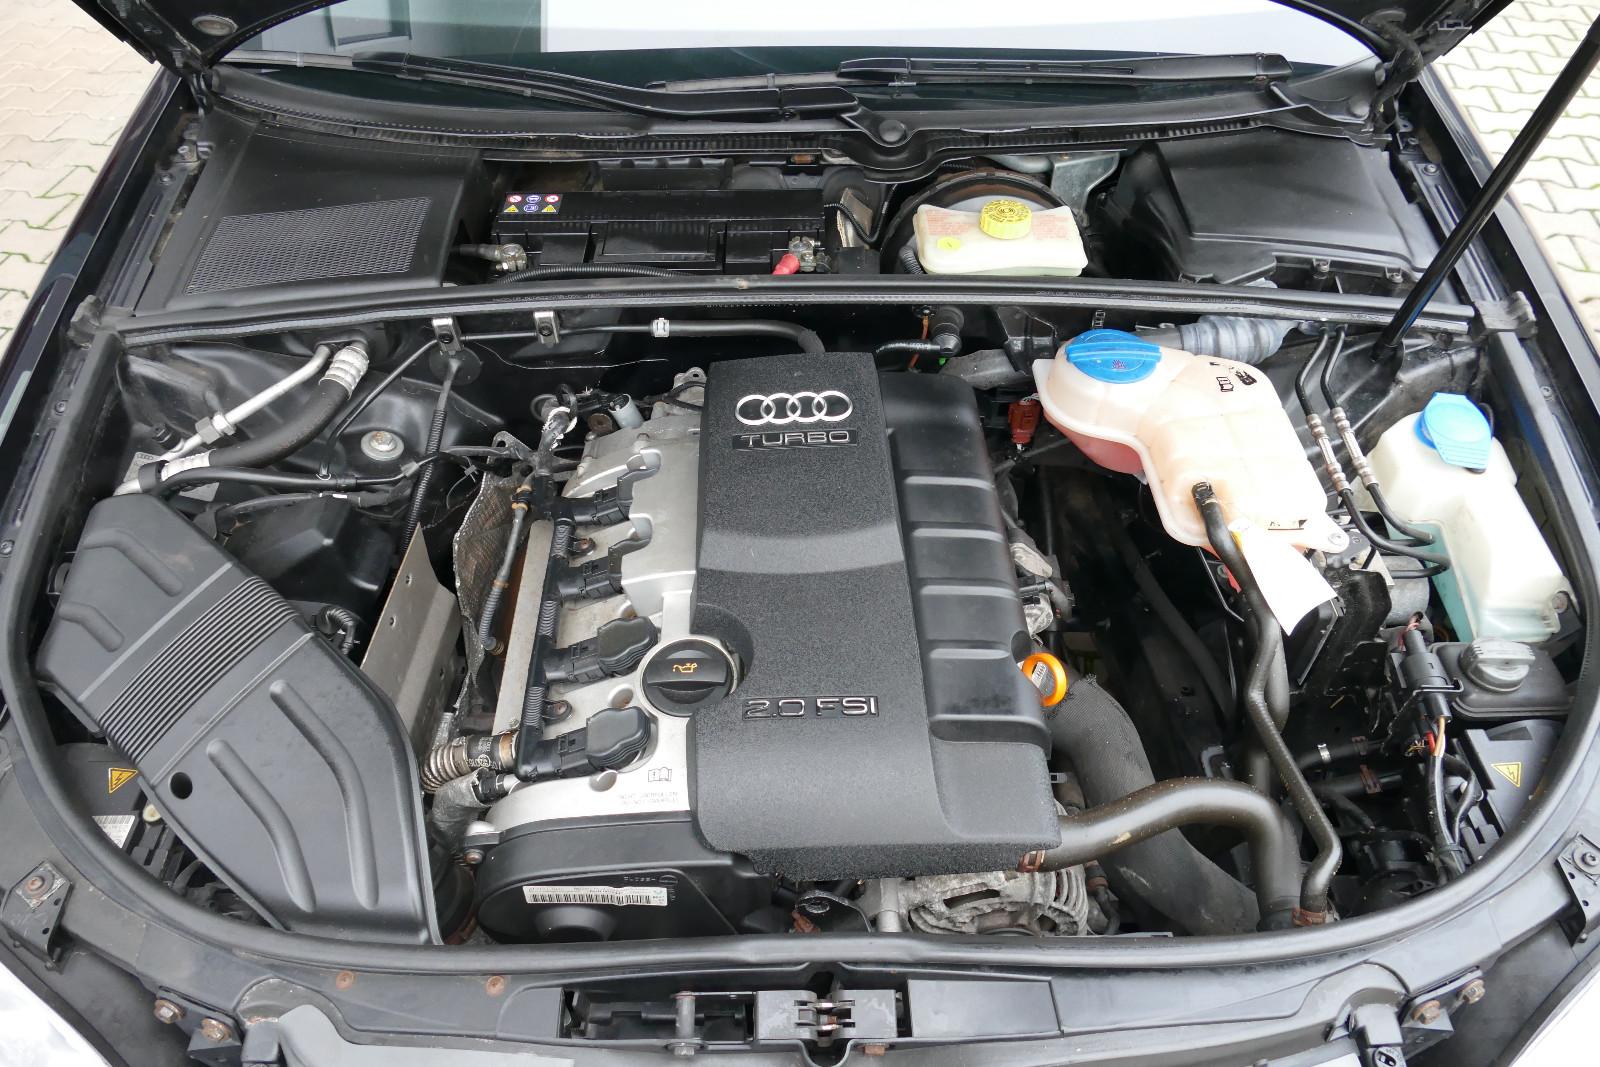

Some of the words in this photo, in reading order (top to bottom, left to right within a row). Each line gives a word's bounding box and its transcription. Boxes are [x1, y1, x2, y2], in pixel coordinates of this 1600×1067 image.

[740, 430, 850, 448] TURBO
[744, 698, 805, 719] 2.0
[816, 696, 877, 716] FSI
